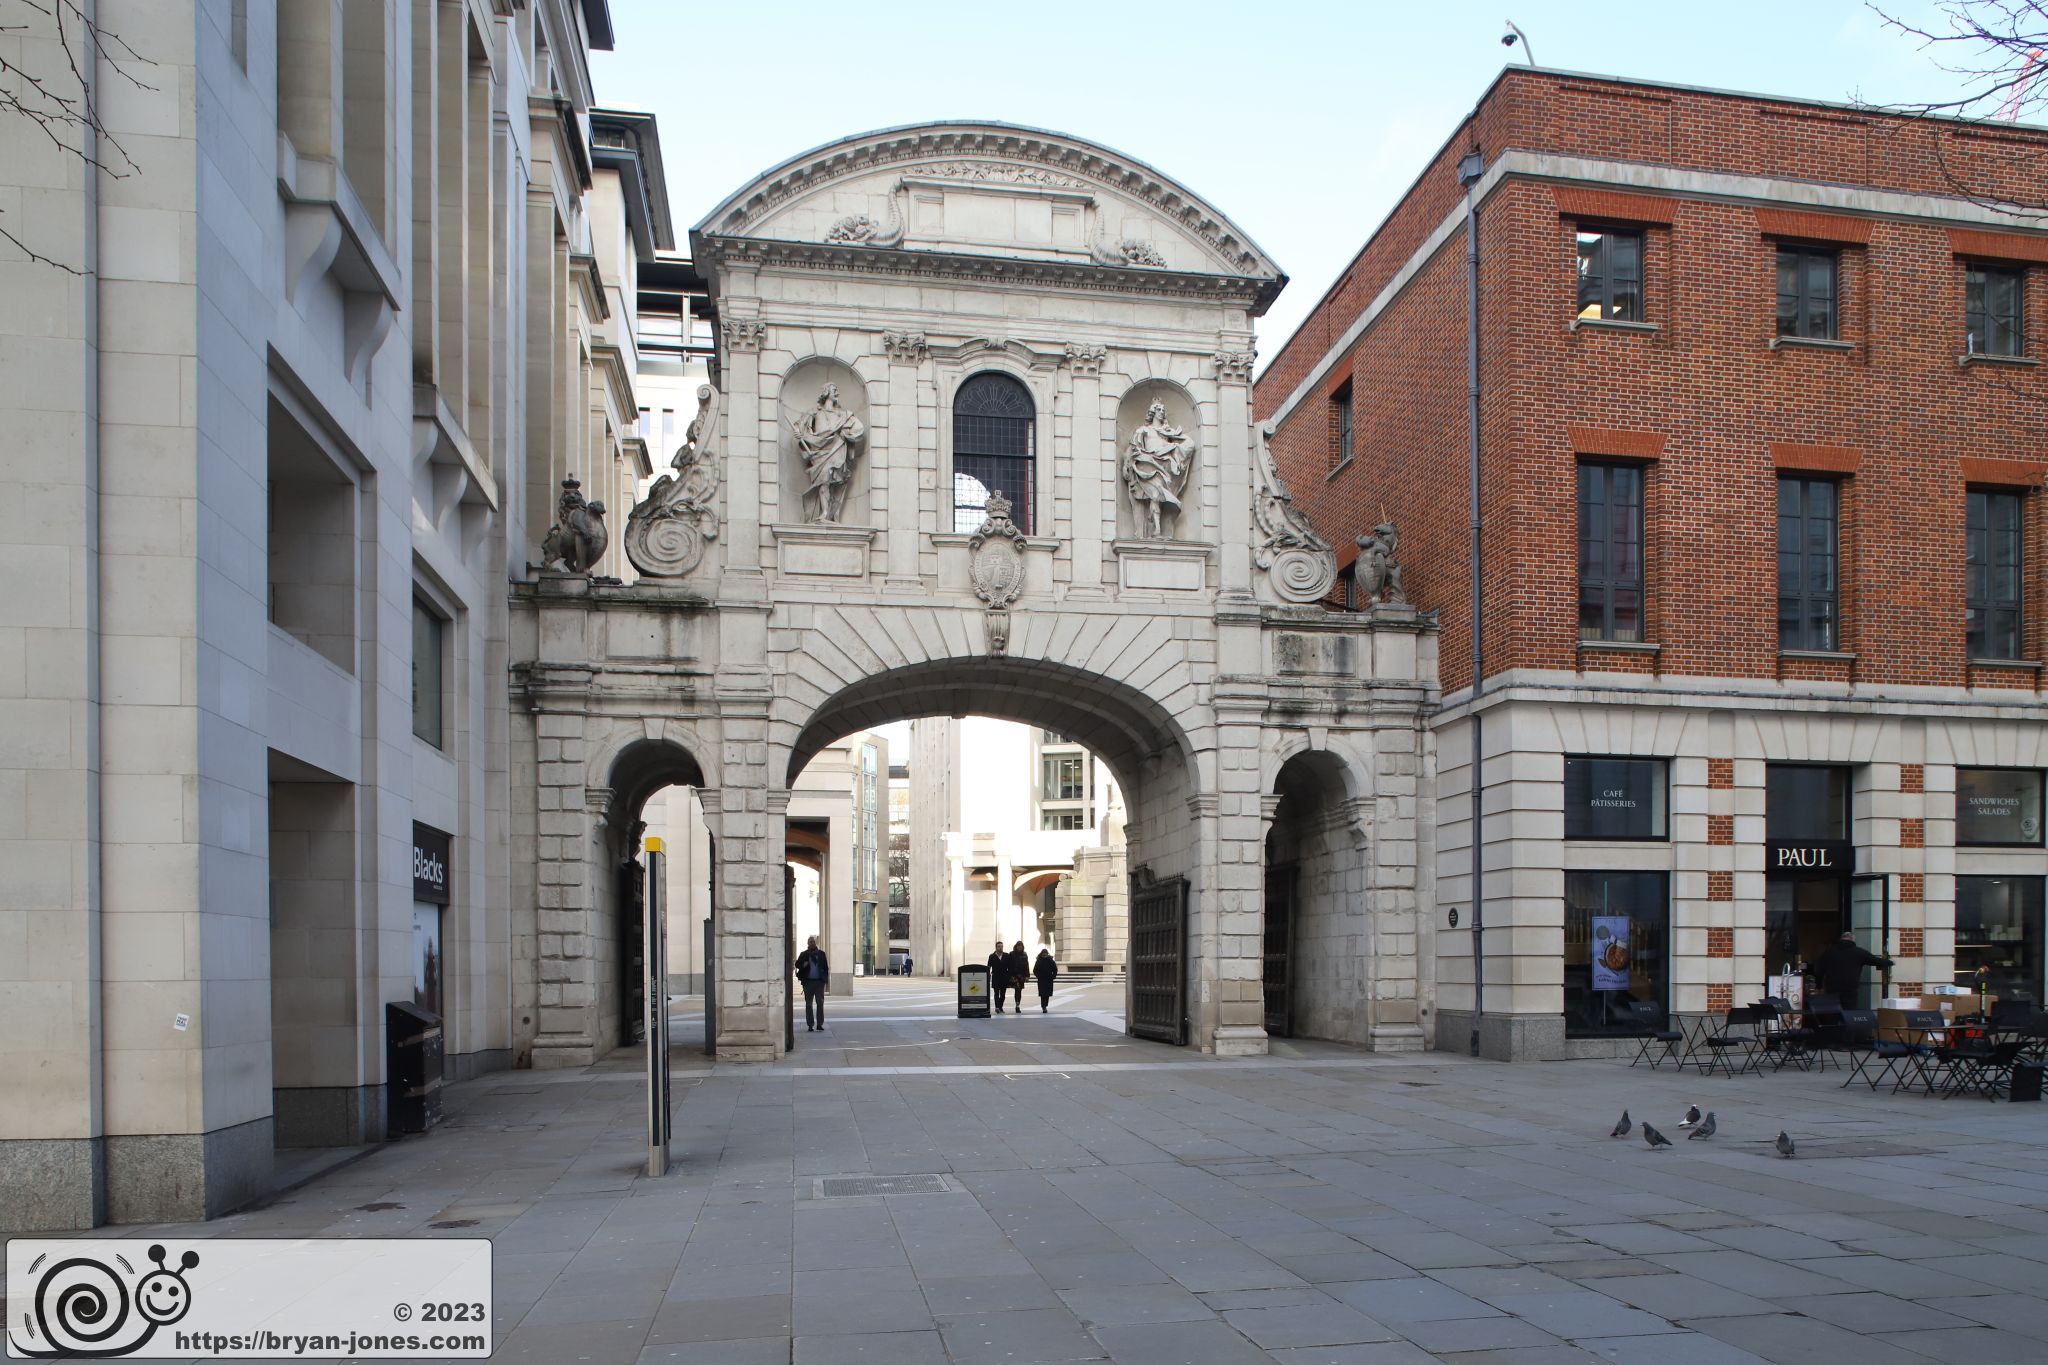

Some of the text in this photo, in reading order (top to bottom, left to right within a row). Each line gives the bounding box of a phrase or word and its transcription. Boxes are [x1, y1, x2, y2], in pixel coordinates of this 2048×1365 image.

[1603, 789, 1623, 798] CAFÉ
[1591, 799, 1636, 808] PÂTISSERIES
[1969, 797, 2019, 806] SANDWICHES
[1978, 808, 2011, 816] SALADES
[1777, 848, 1832, 866] PAUL
[413, 846, 443, 884] Blacks
